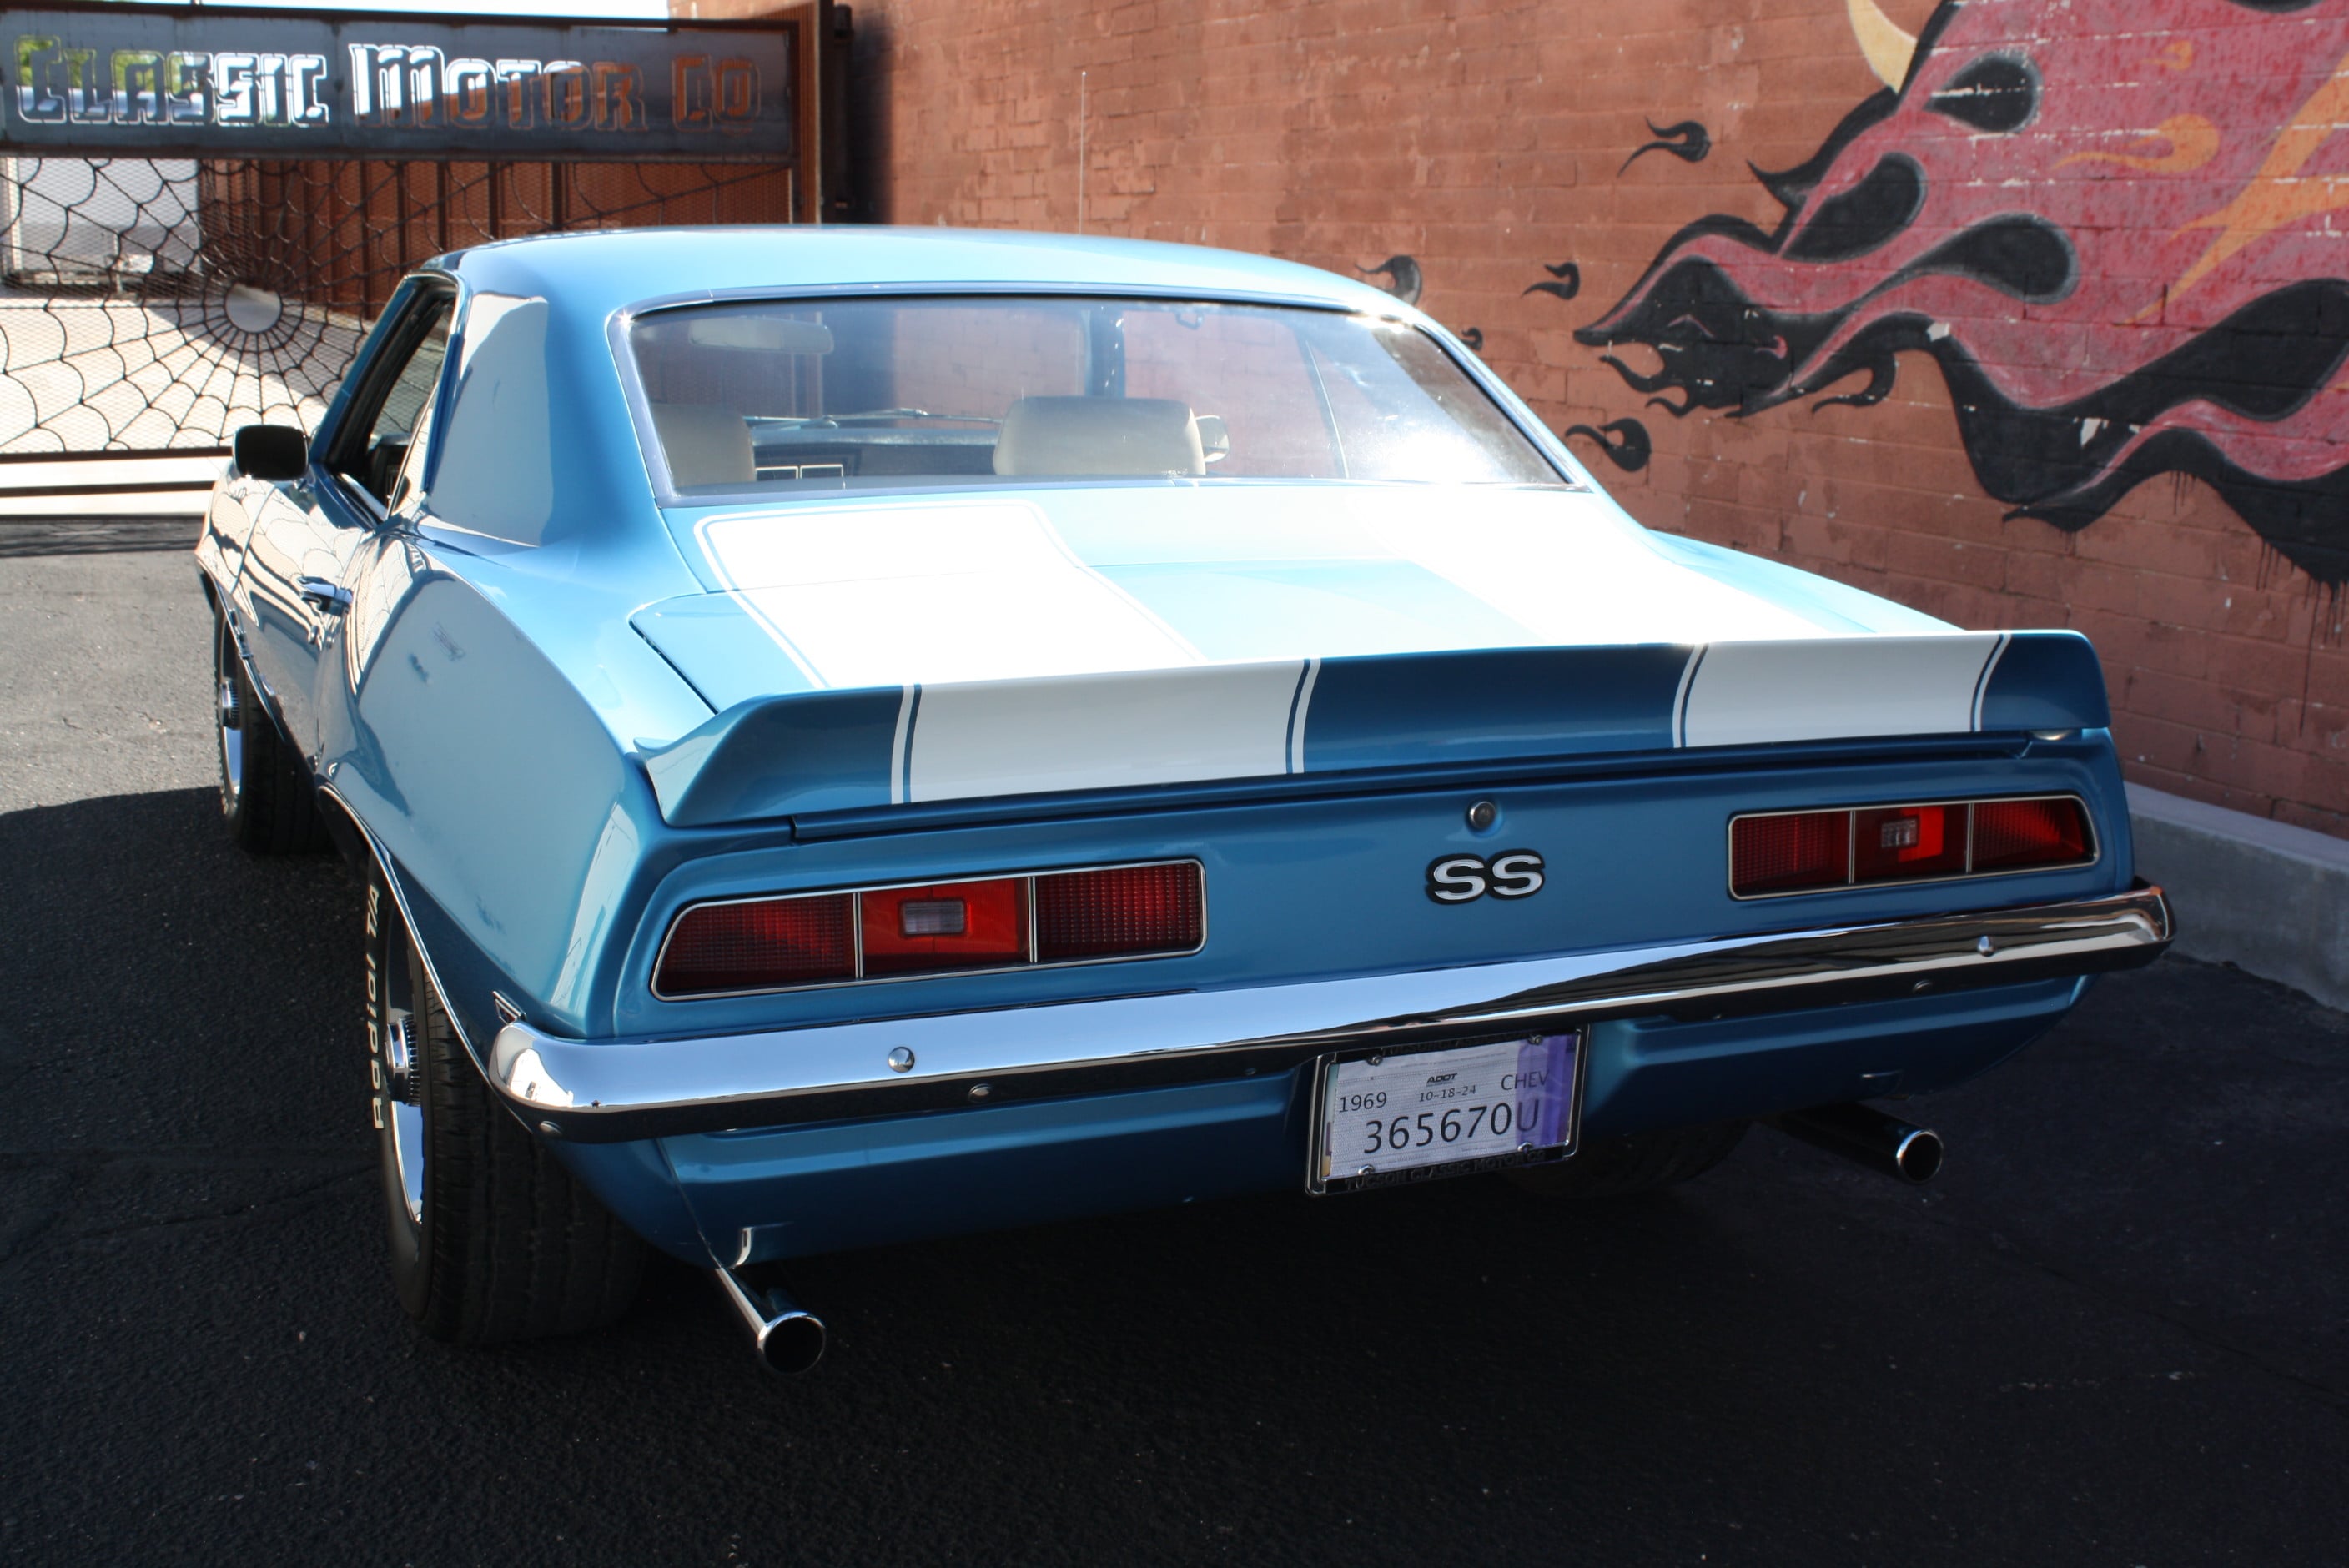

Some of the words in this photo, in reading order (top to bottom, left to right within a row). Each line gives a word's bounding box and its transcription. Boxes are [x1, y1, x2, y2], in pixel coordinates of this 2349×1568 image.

[1430, 851, 1544, 902] SS
[365, 953, 384, 1129] Radial
[1426, 1073, 1458, 1084] ADOT
[1501, 1069, 1549, 1091] CHEV
[1338, 1091, 1387, 1113] 1969
[1419, 1084, 1476, 1103] 10-18-24
[1364, 1098, 1540, 1154] 365670U
[1345, 1169, 1408, 1192] TUCSON
[1410, 1159, 1471, 1182] CLASSIC
